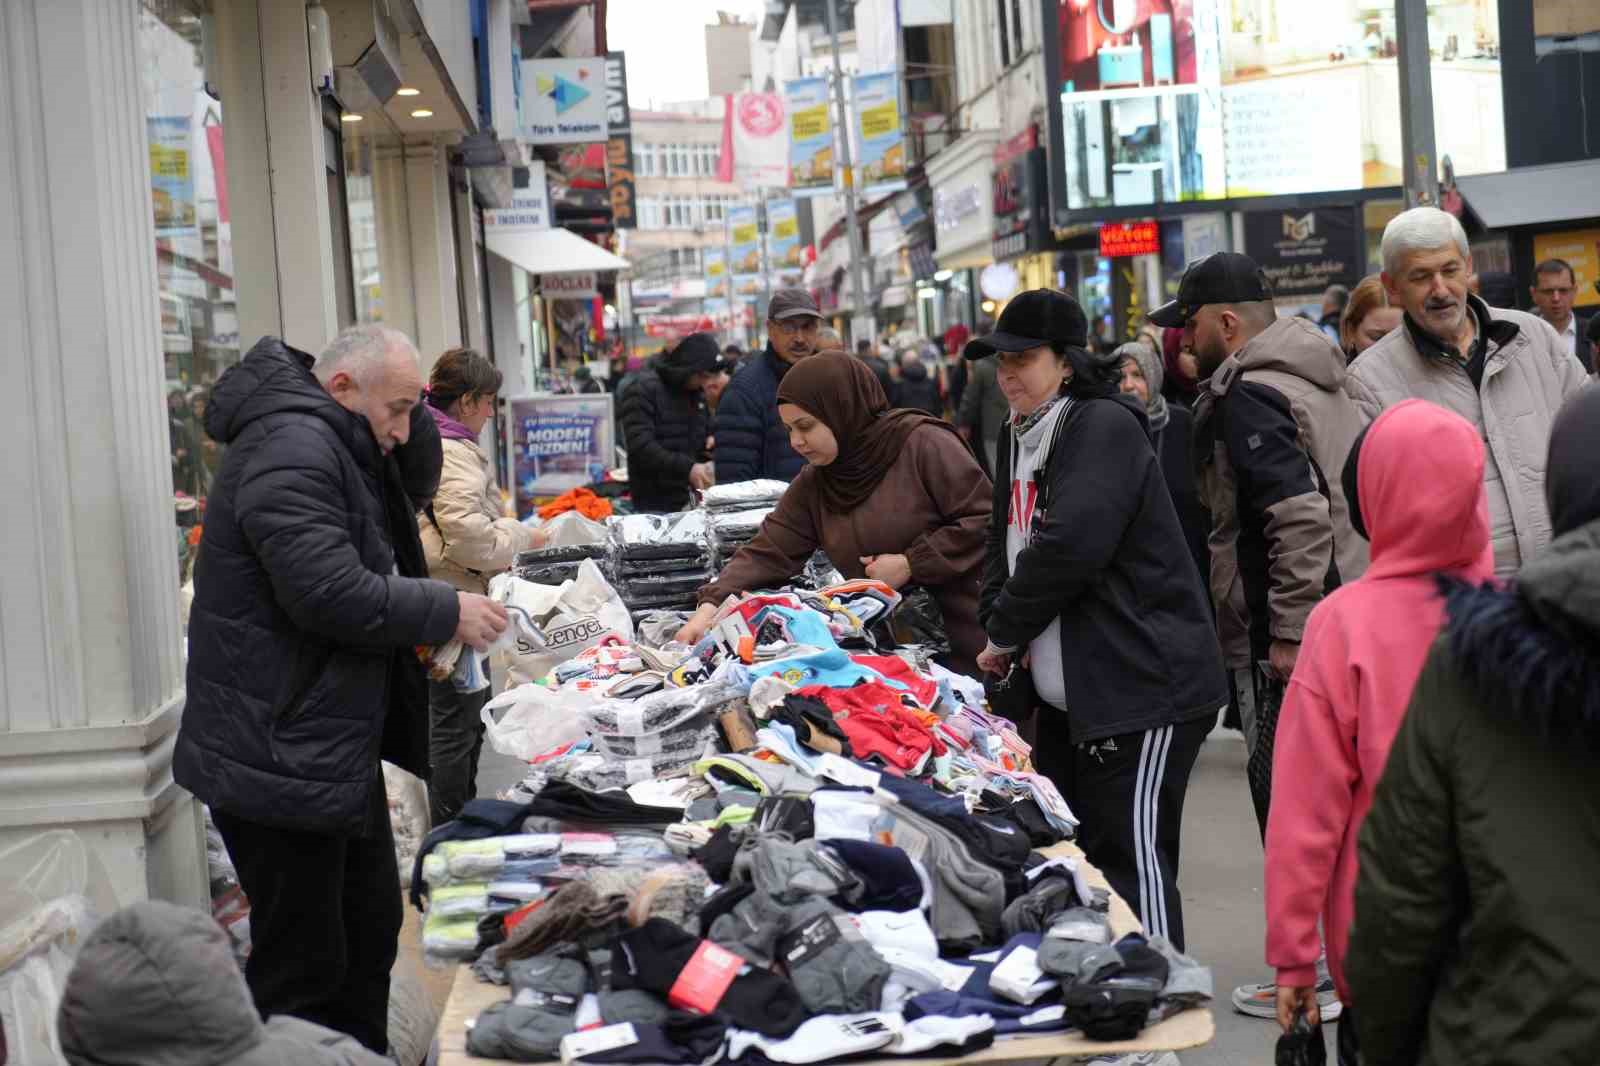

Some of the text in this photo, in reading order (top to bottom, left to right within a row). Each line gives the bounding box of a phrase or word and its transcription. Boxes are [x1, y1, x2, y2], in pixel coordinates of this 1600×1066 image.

[558, 122, 601, 133] Telekom
[527, 426, 592, 443] MODEM
[529, 440, 590, 456] BİZDEN!
[516, 618, 604, 653] Szenger
